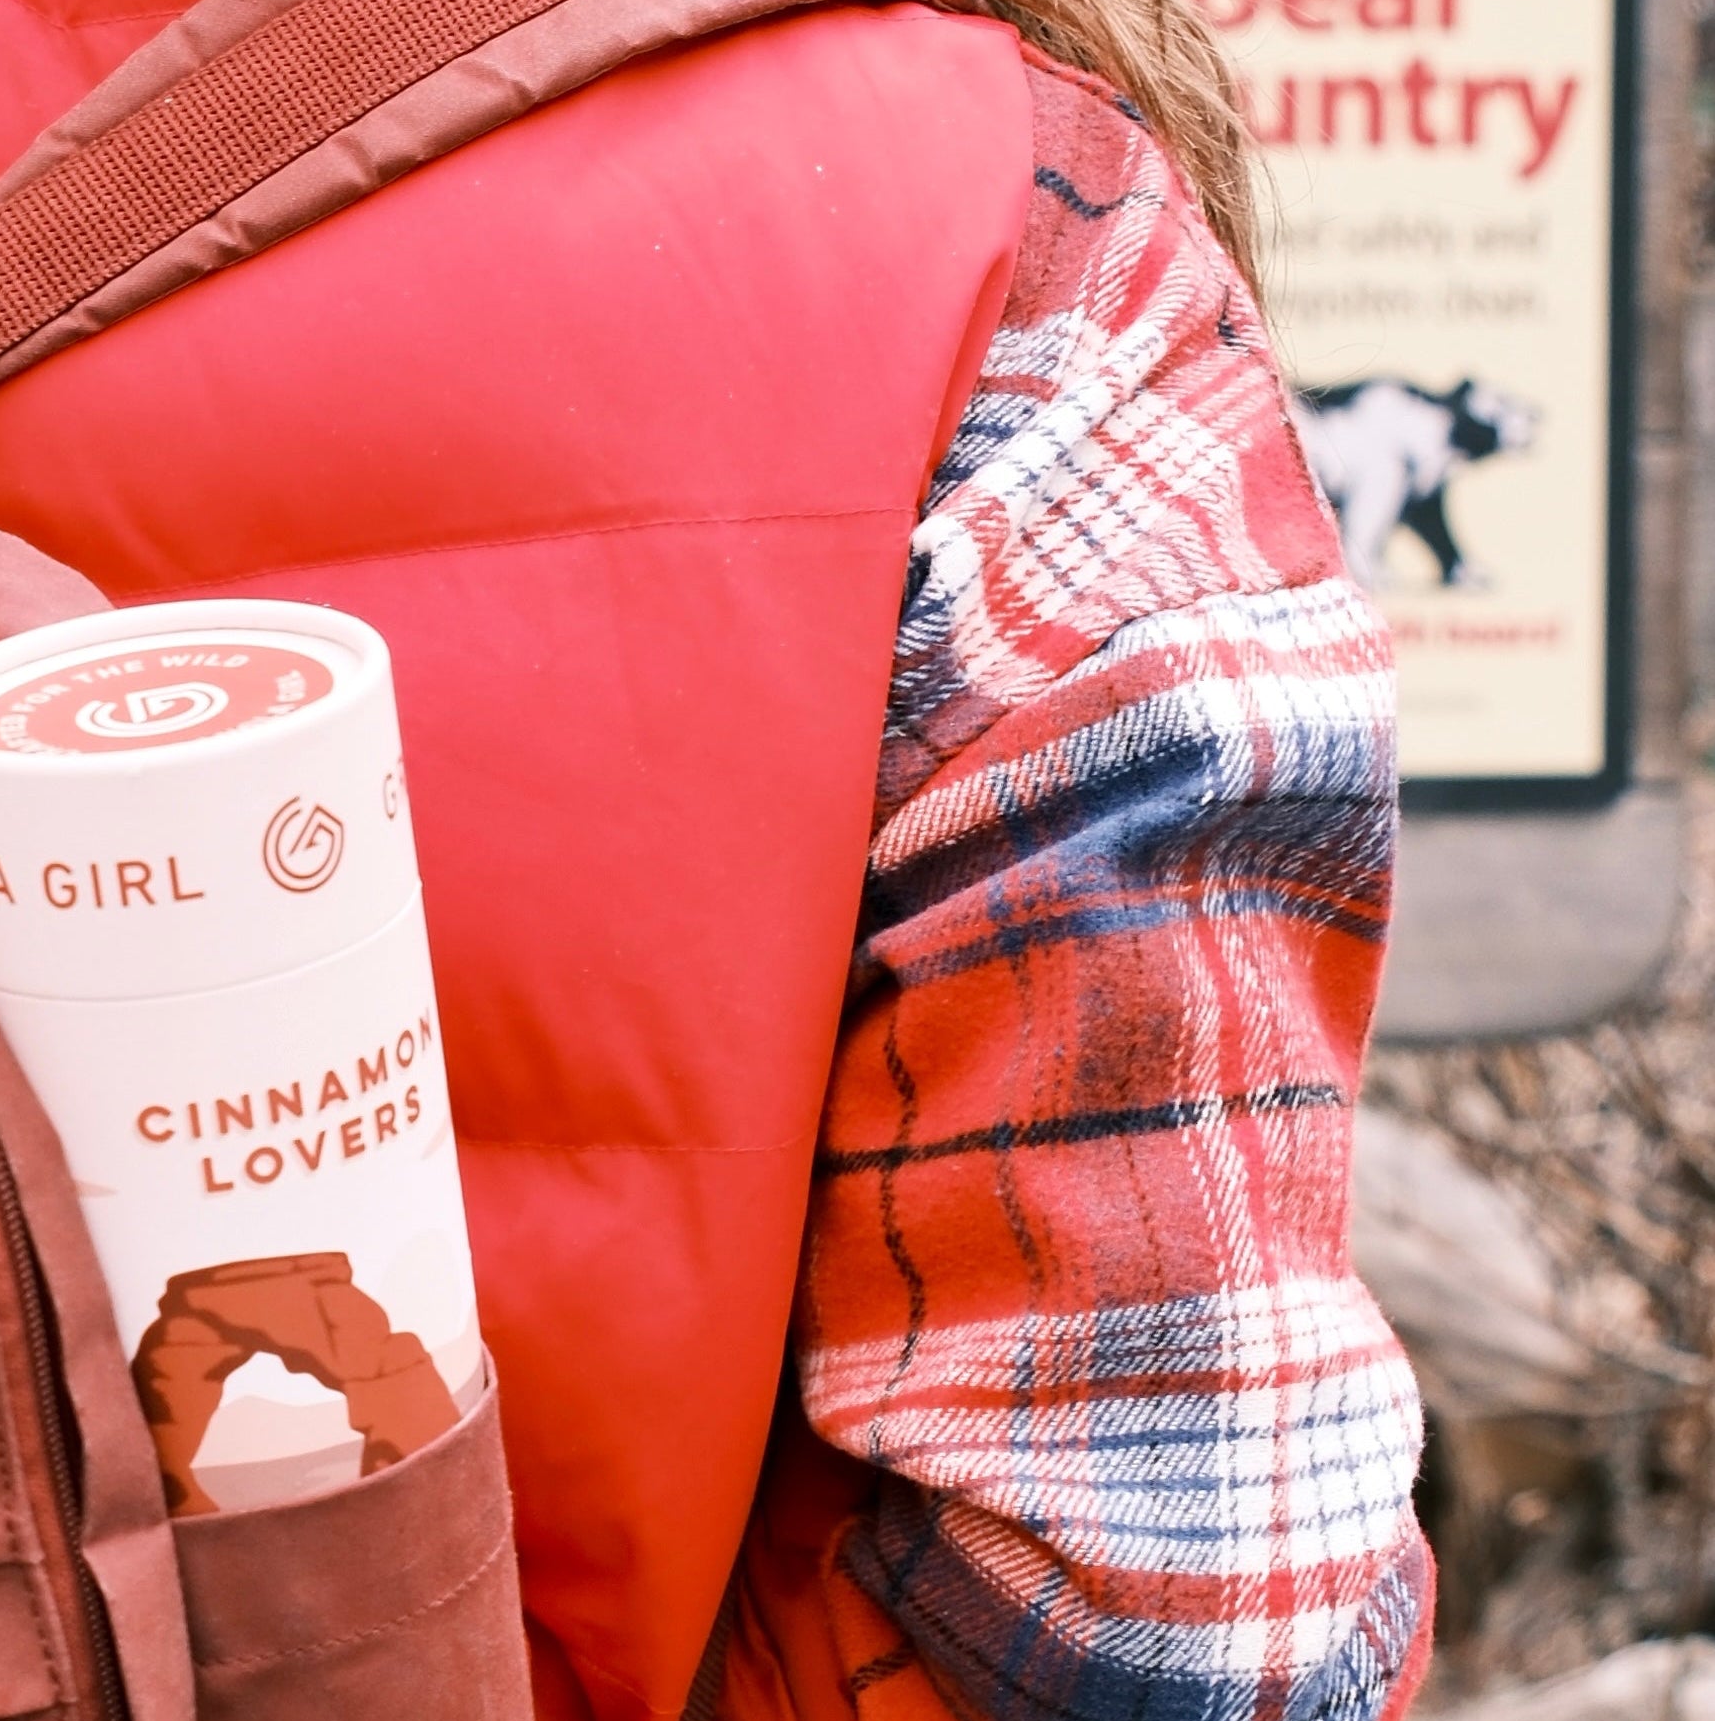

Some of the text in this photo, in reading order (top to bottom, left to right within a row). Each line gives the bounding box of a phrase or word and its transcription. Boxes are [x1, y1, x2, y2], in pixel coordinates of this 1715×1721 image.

[1239, 58, 1582, 182] untry
[73, 658, 145, 685] THE
[159, 652, 251, 670] WILD
[42, 856, 204, 911] GIRL
[136, 1006, 435, 1143] CINNAMON
[201, 1083, 424, 1196] LOVERS
